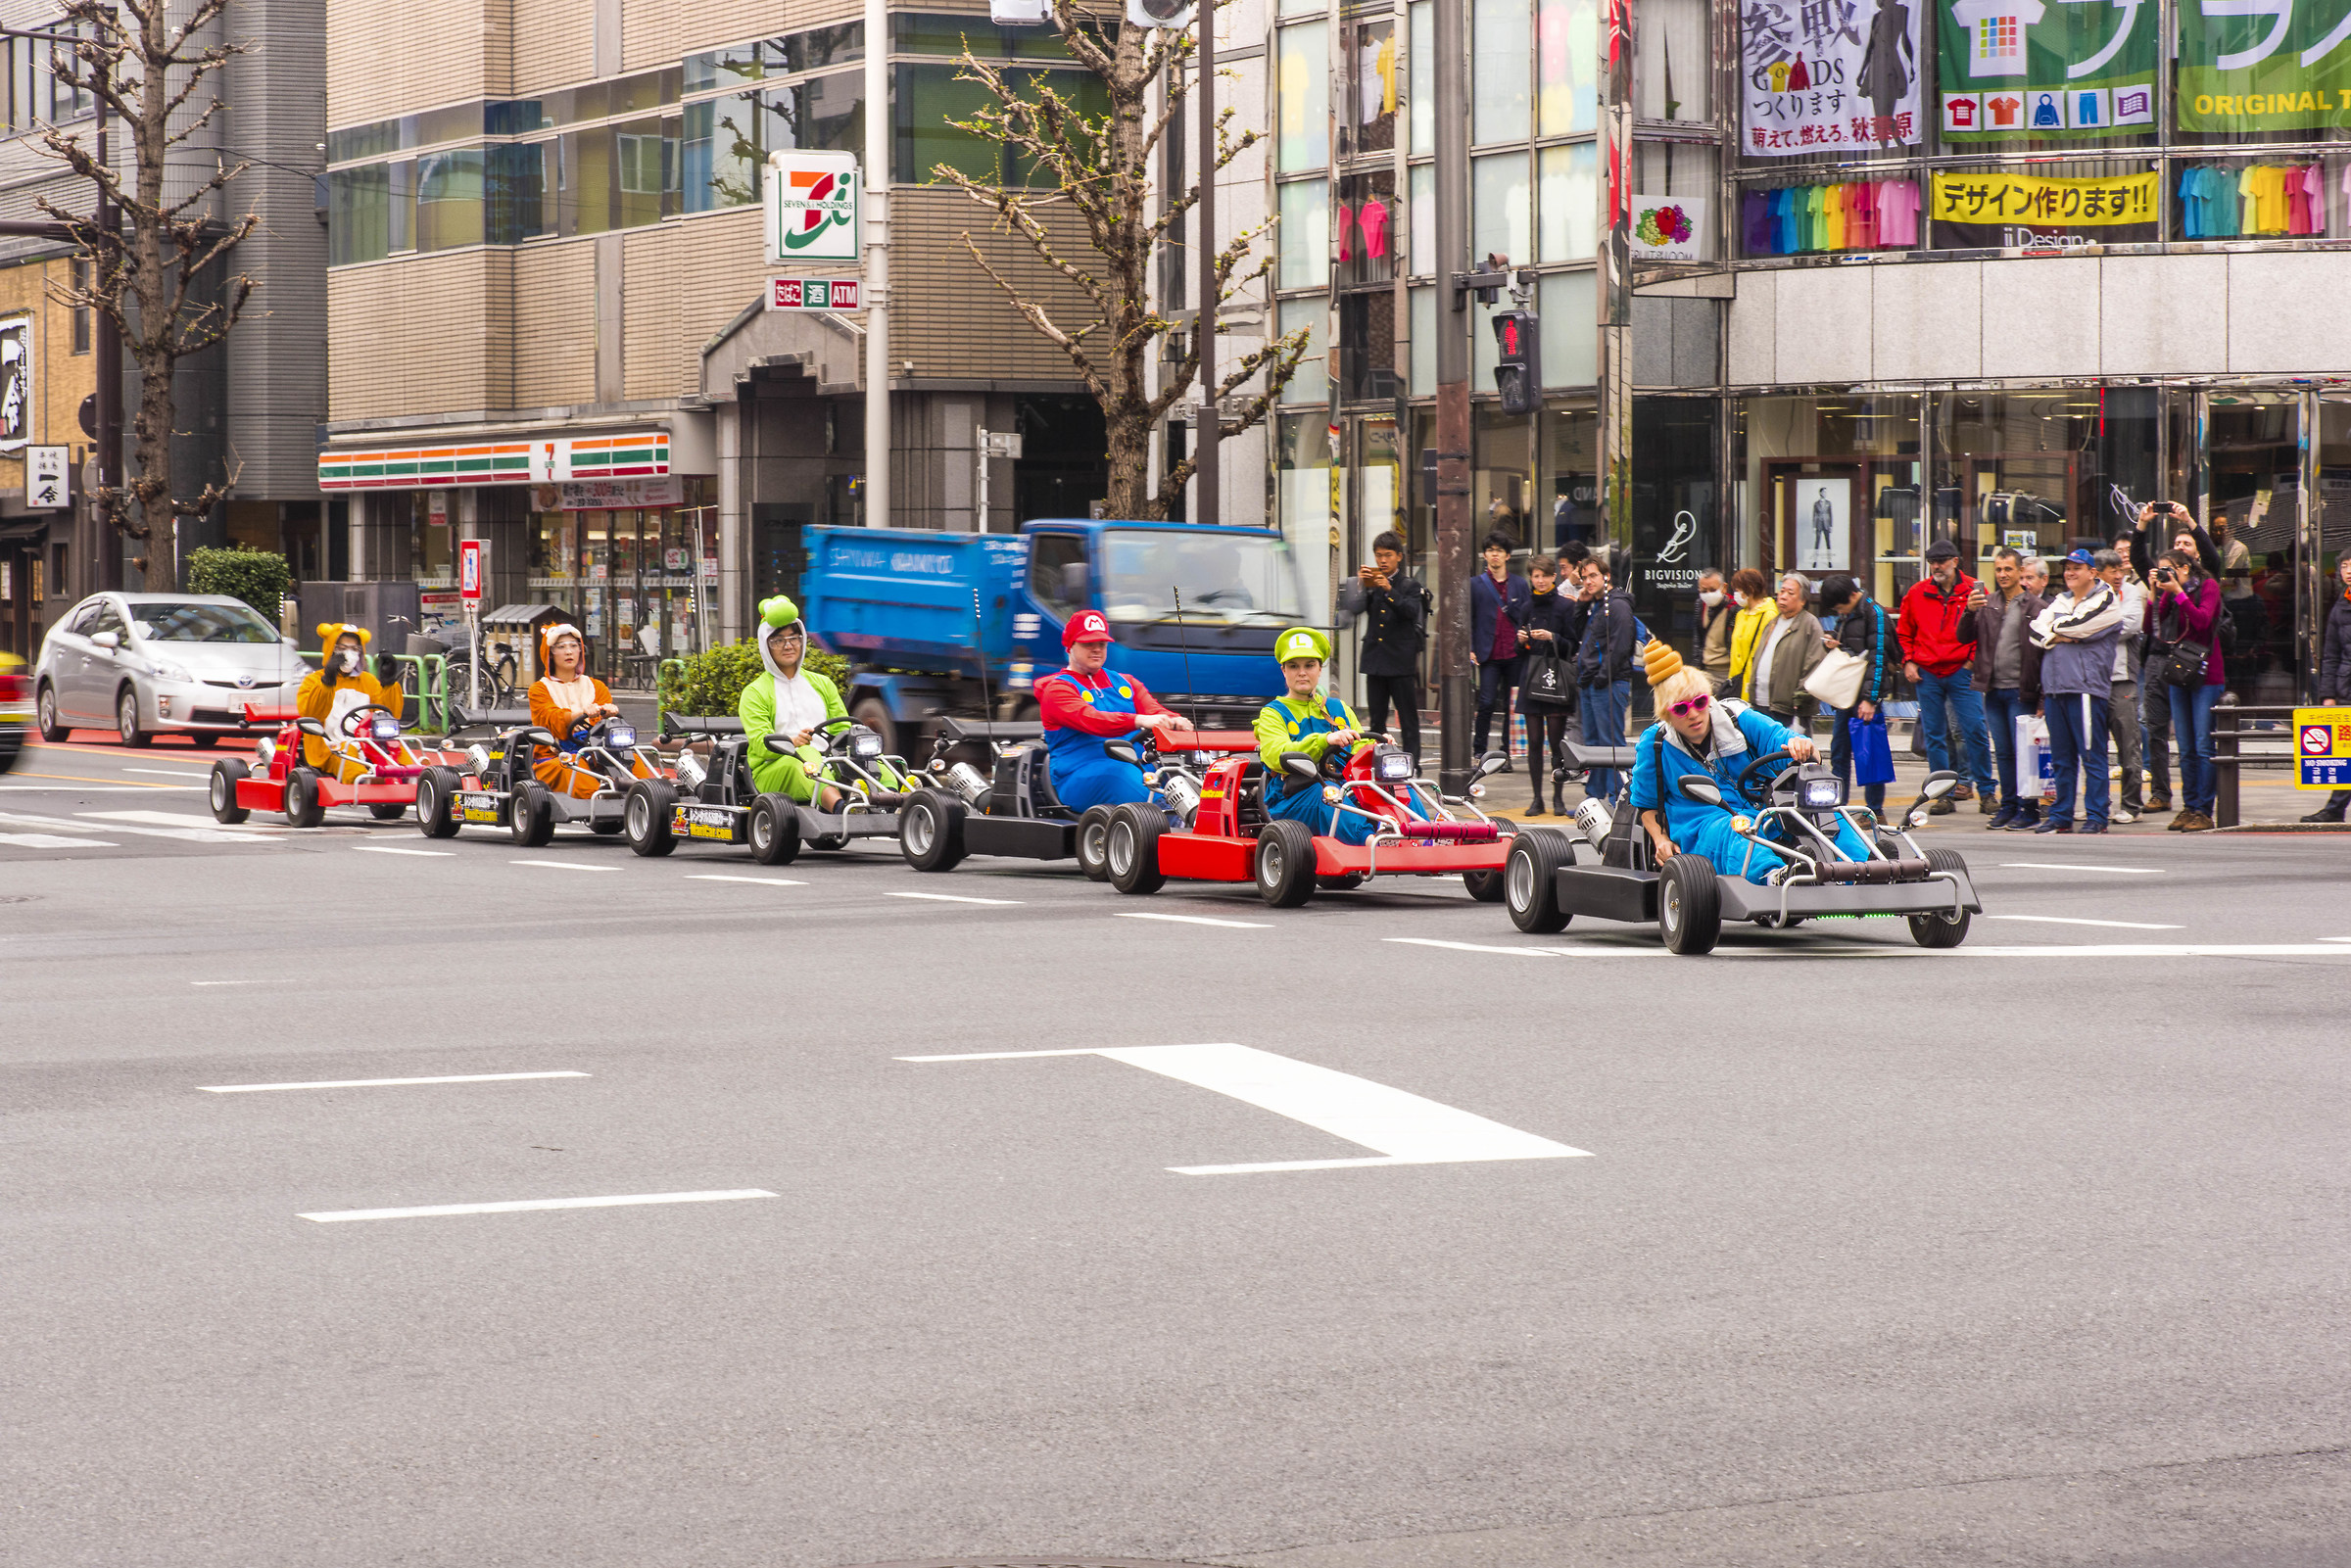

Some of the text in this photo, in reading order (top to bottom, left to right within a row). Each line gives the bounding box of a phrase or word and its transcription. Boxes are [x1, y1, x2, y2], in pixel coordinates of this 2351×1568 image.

[1753, 89, 1847, 120] つくります
[2194, 90, 2332, 116] ORIGINAL
[816, 201, 852, 210] HOLDINGS
[1944, 183, 2148, 218] デザイン作ります!!
[776, 284, 857, 305] たばこ 酒 ATM
[1645, 569, 1703, 581] BIGVISION
[1088, 619, 1103, 628] M
[1296, 636, 1306, 646] L
